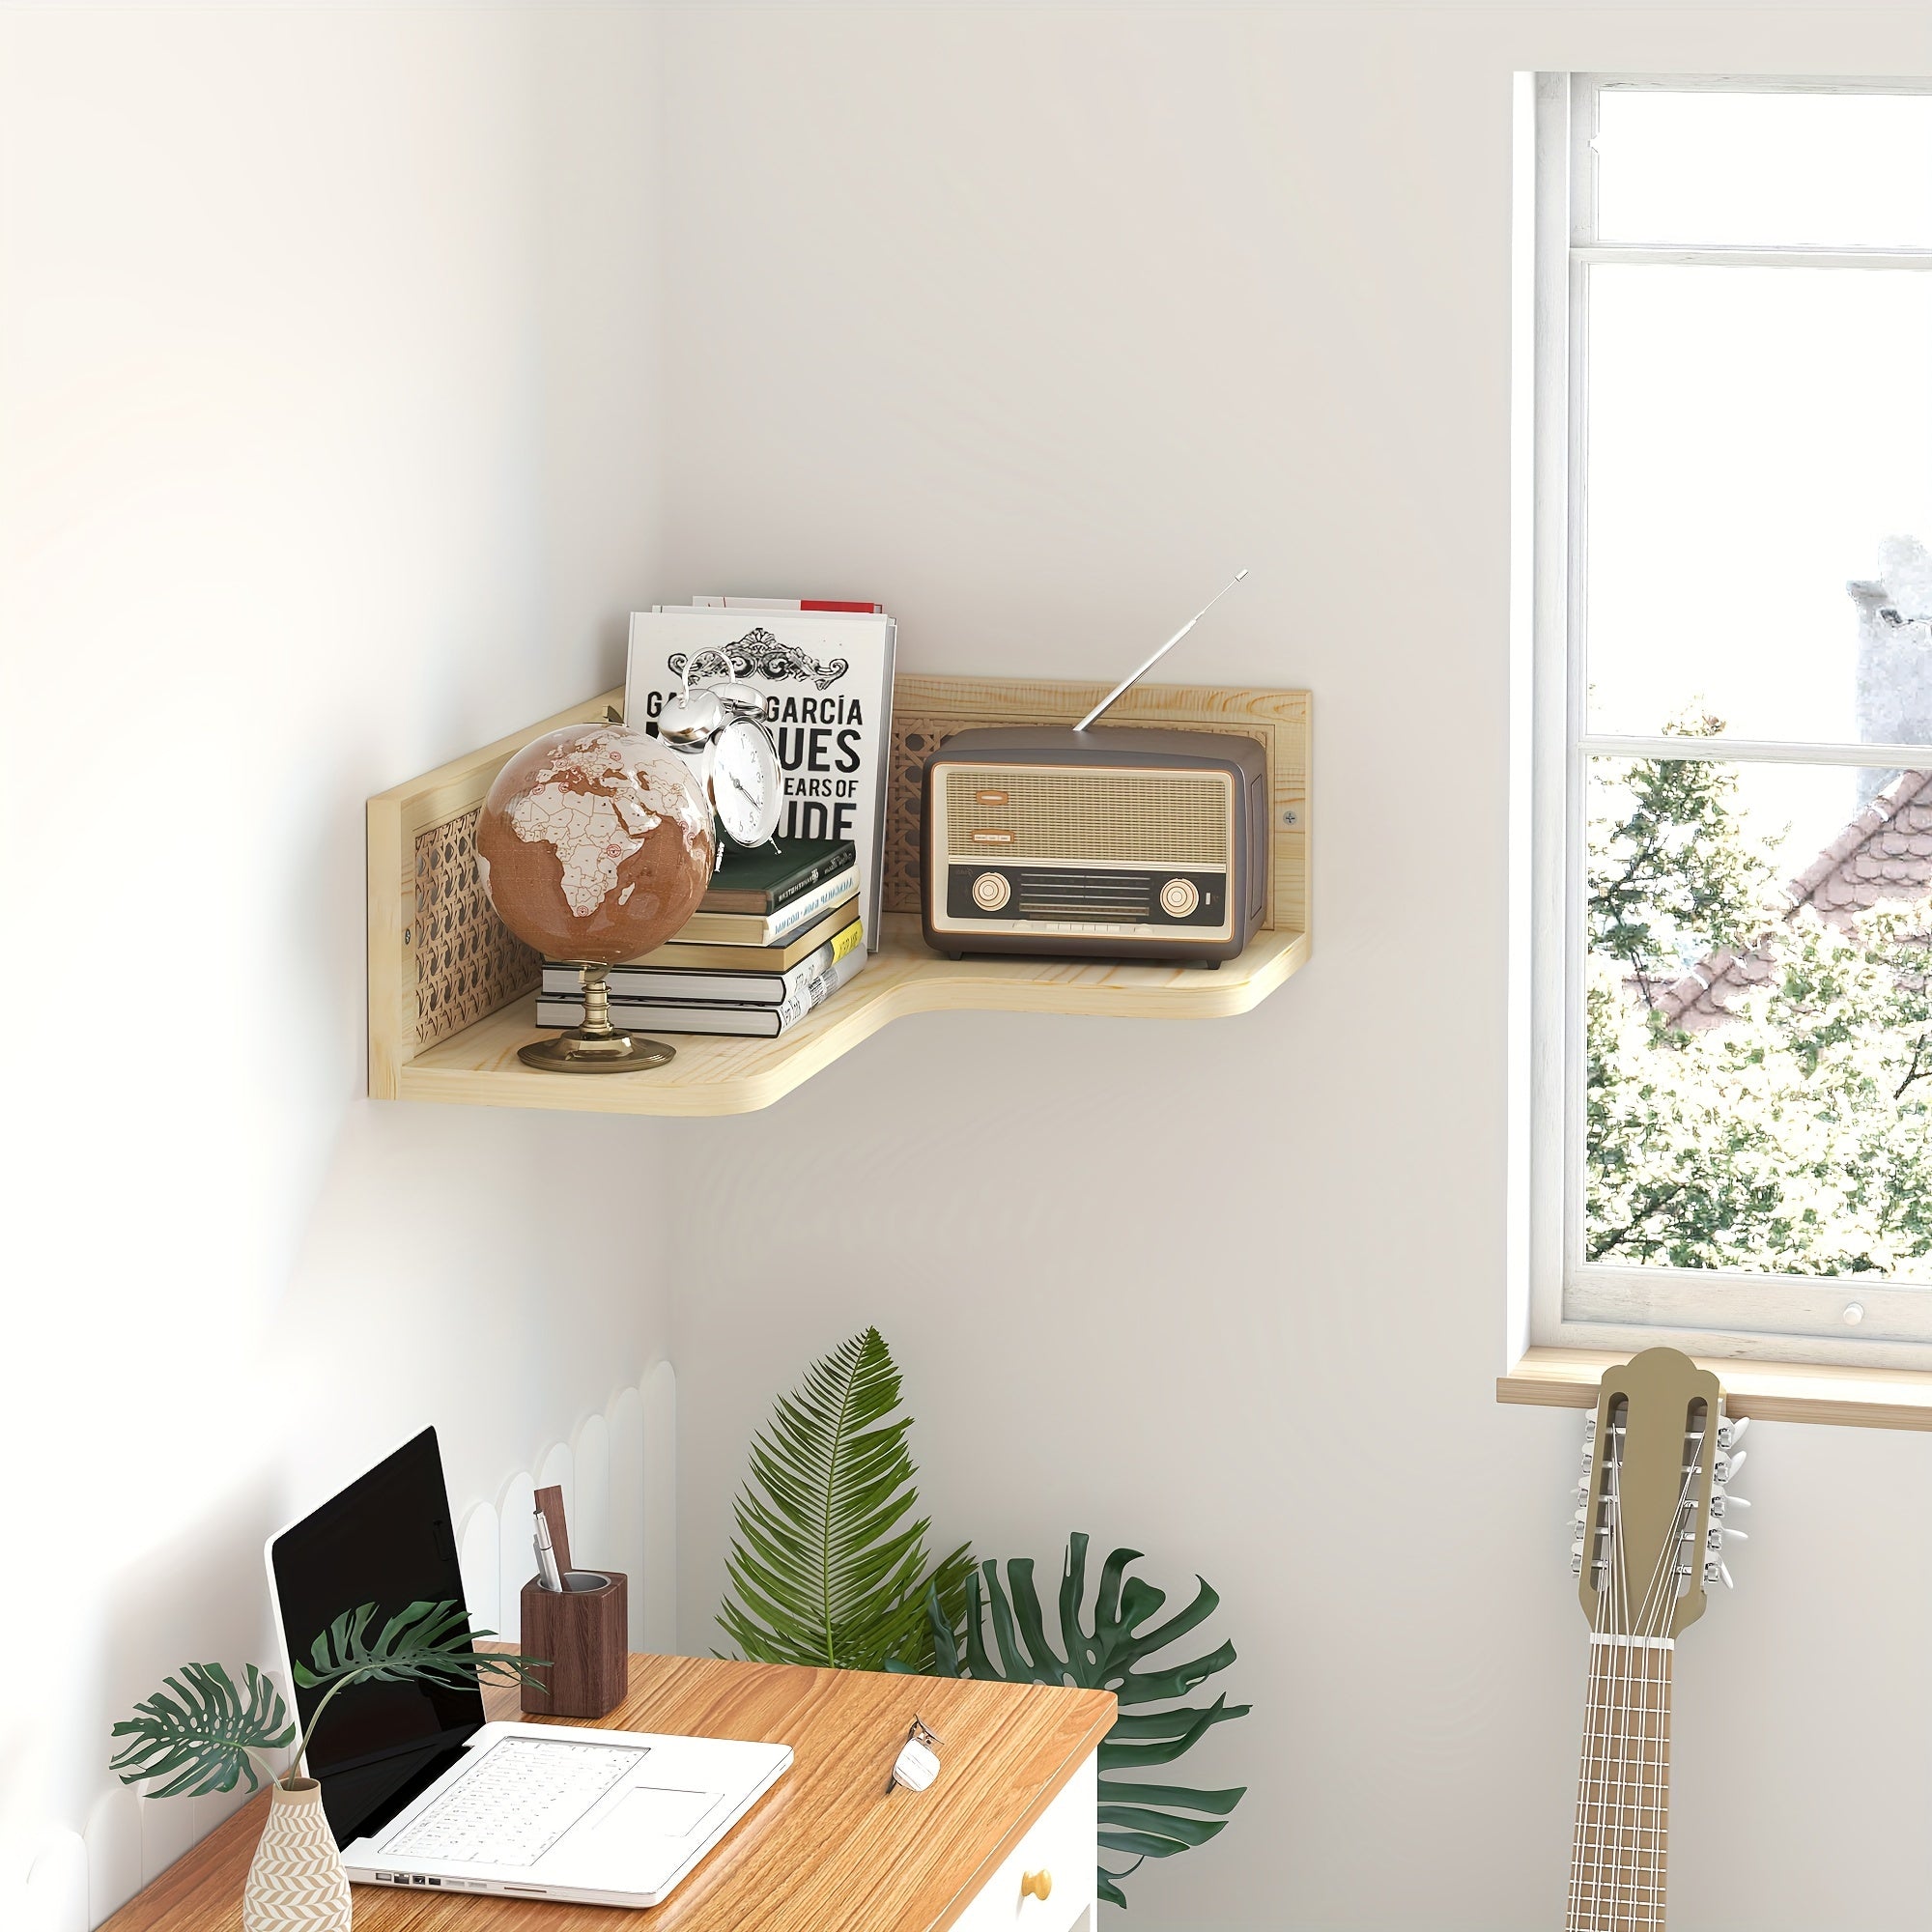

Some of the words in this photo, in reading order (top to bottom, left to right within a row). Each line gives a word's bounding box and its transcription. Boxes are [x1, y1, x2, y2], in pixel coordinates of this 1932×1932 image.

[767, 695, 863, 725] GARCÍA
[783, 777, 834, 797] EARS
[836, 780, 859, 798] OF
